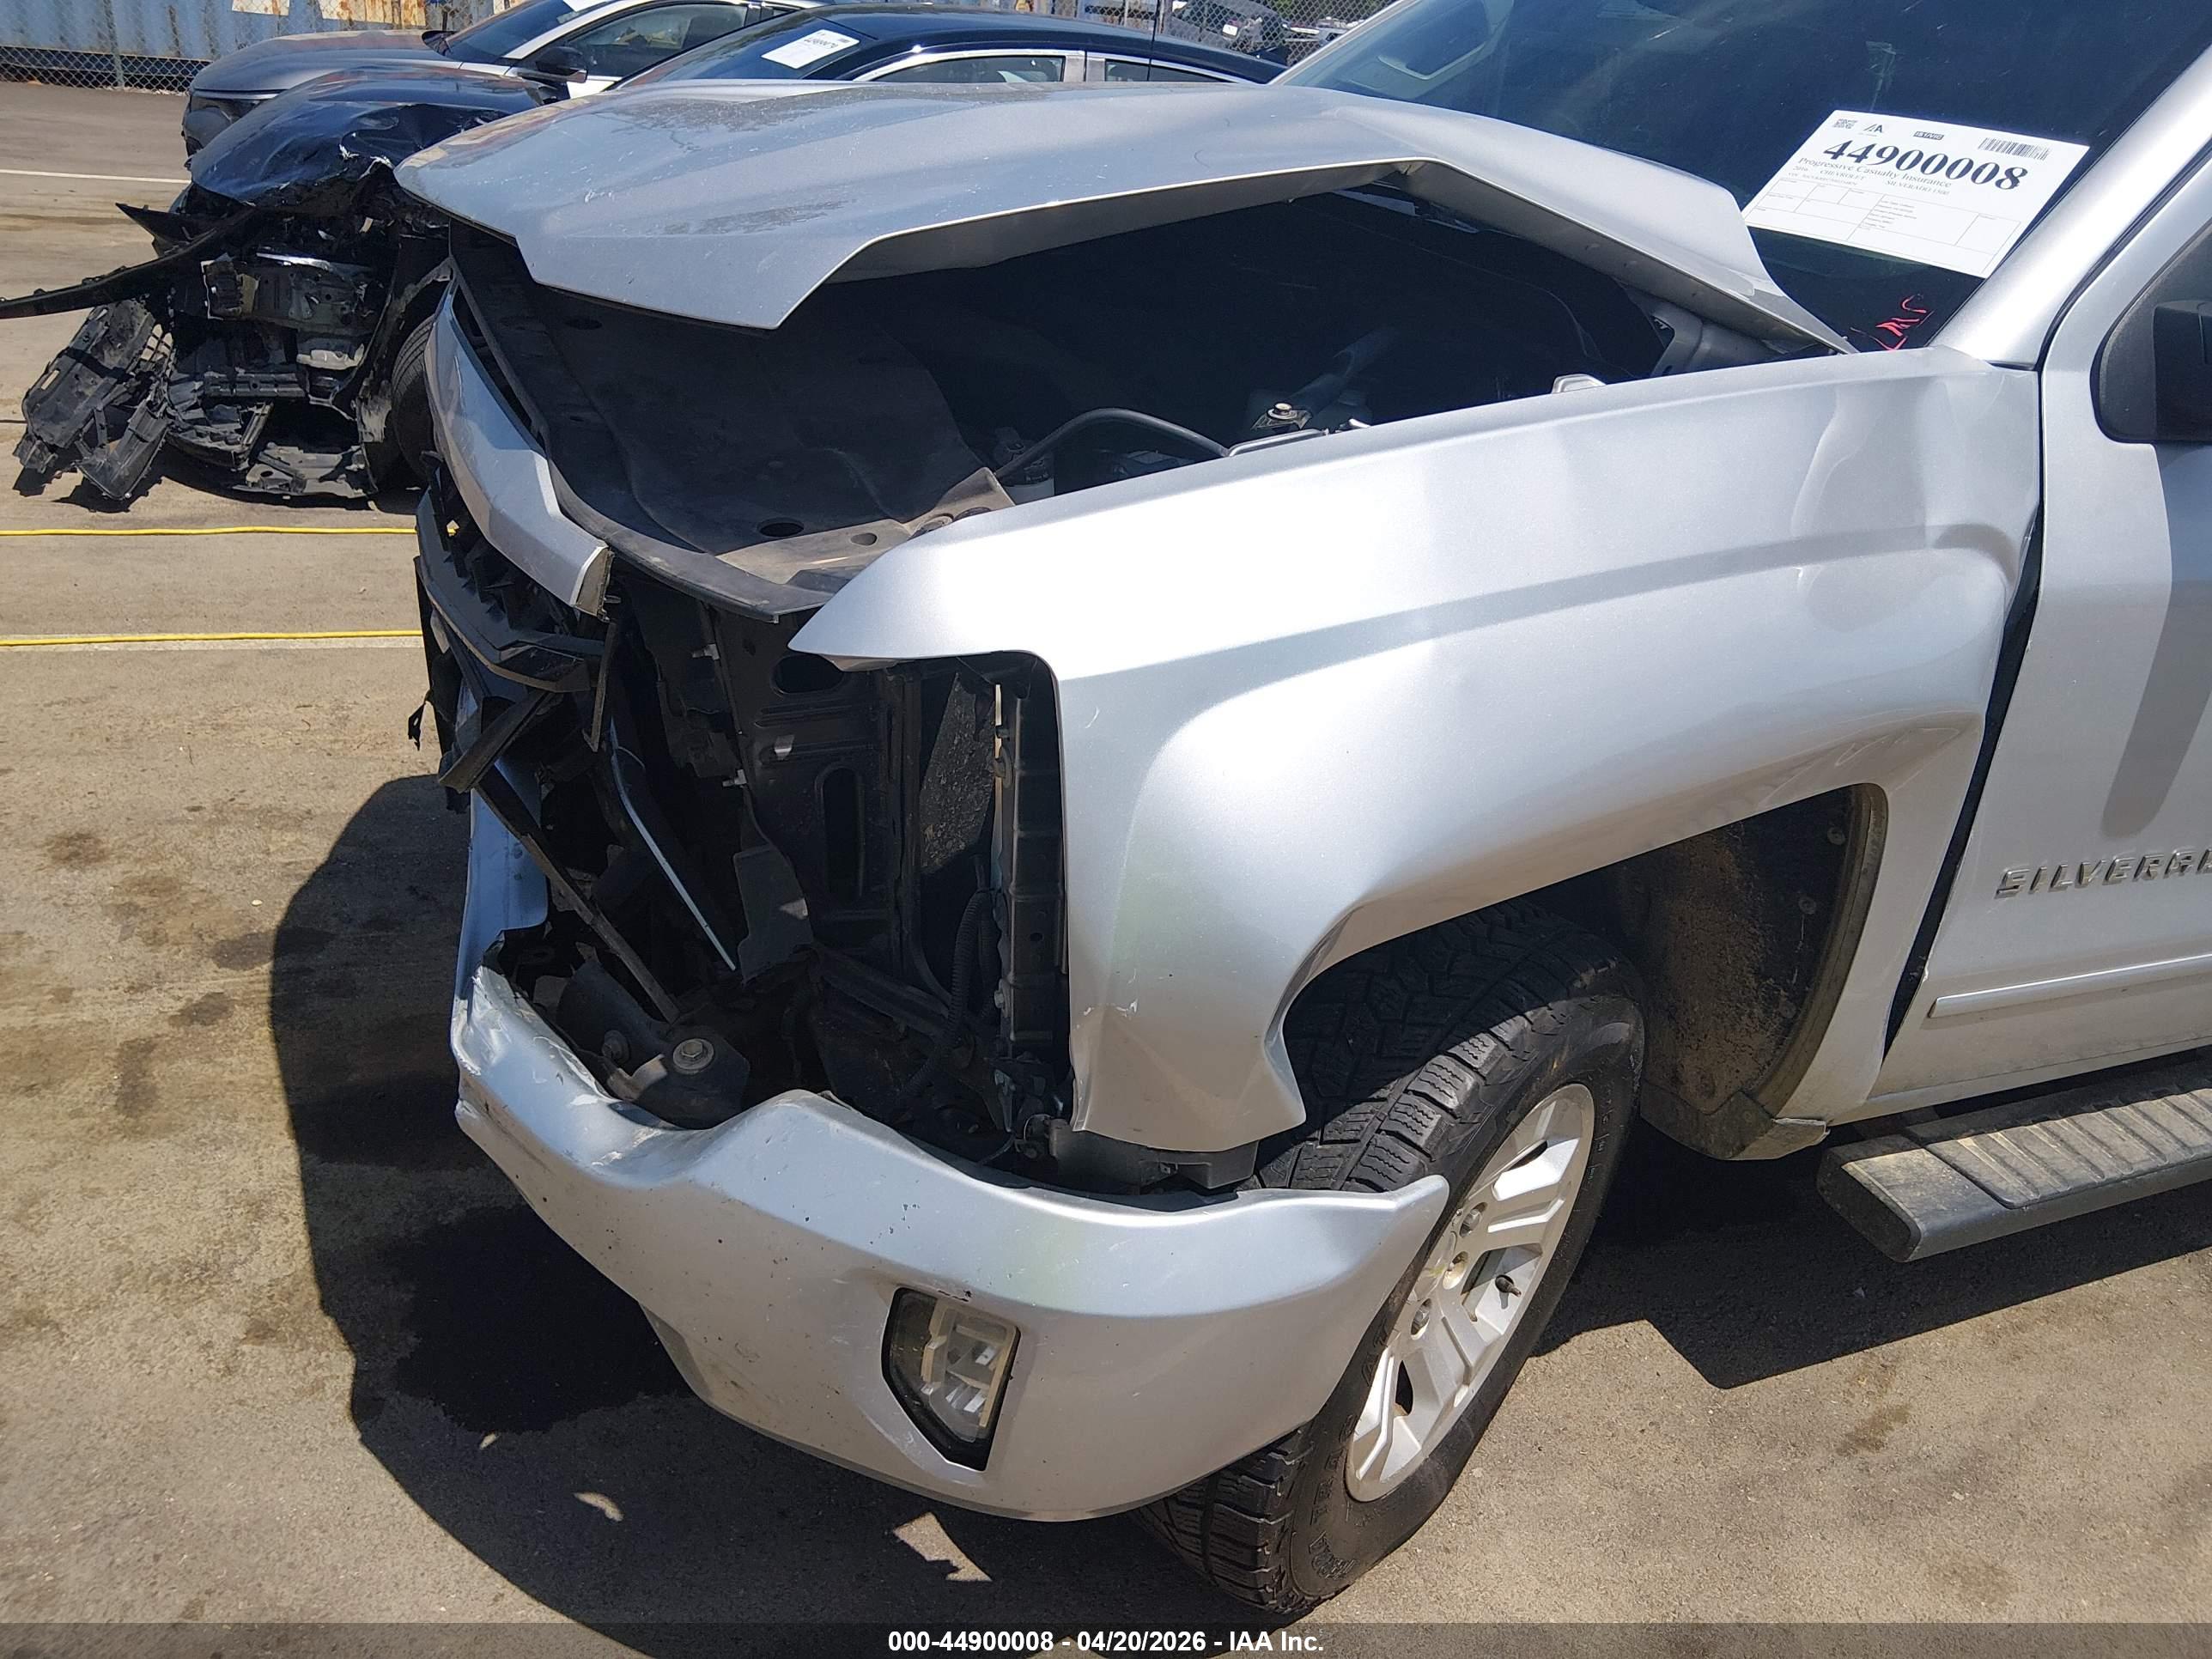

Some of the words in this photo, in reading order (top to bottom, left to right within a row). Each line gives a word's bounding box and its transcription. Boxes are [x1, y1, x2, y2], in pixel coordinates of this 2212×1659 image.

[1798, 157, 1853, 173] Progressive
[1856, 165, 1899, 179] Casualty
[1901, 173, 1952, 188] Insurance
[1823, 140, 2028, 191] 44900008
